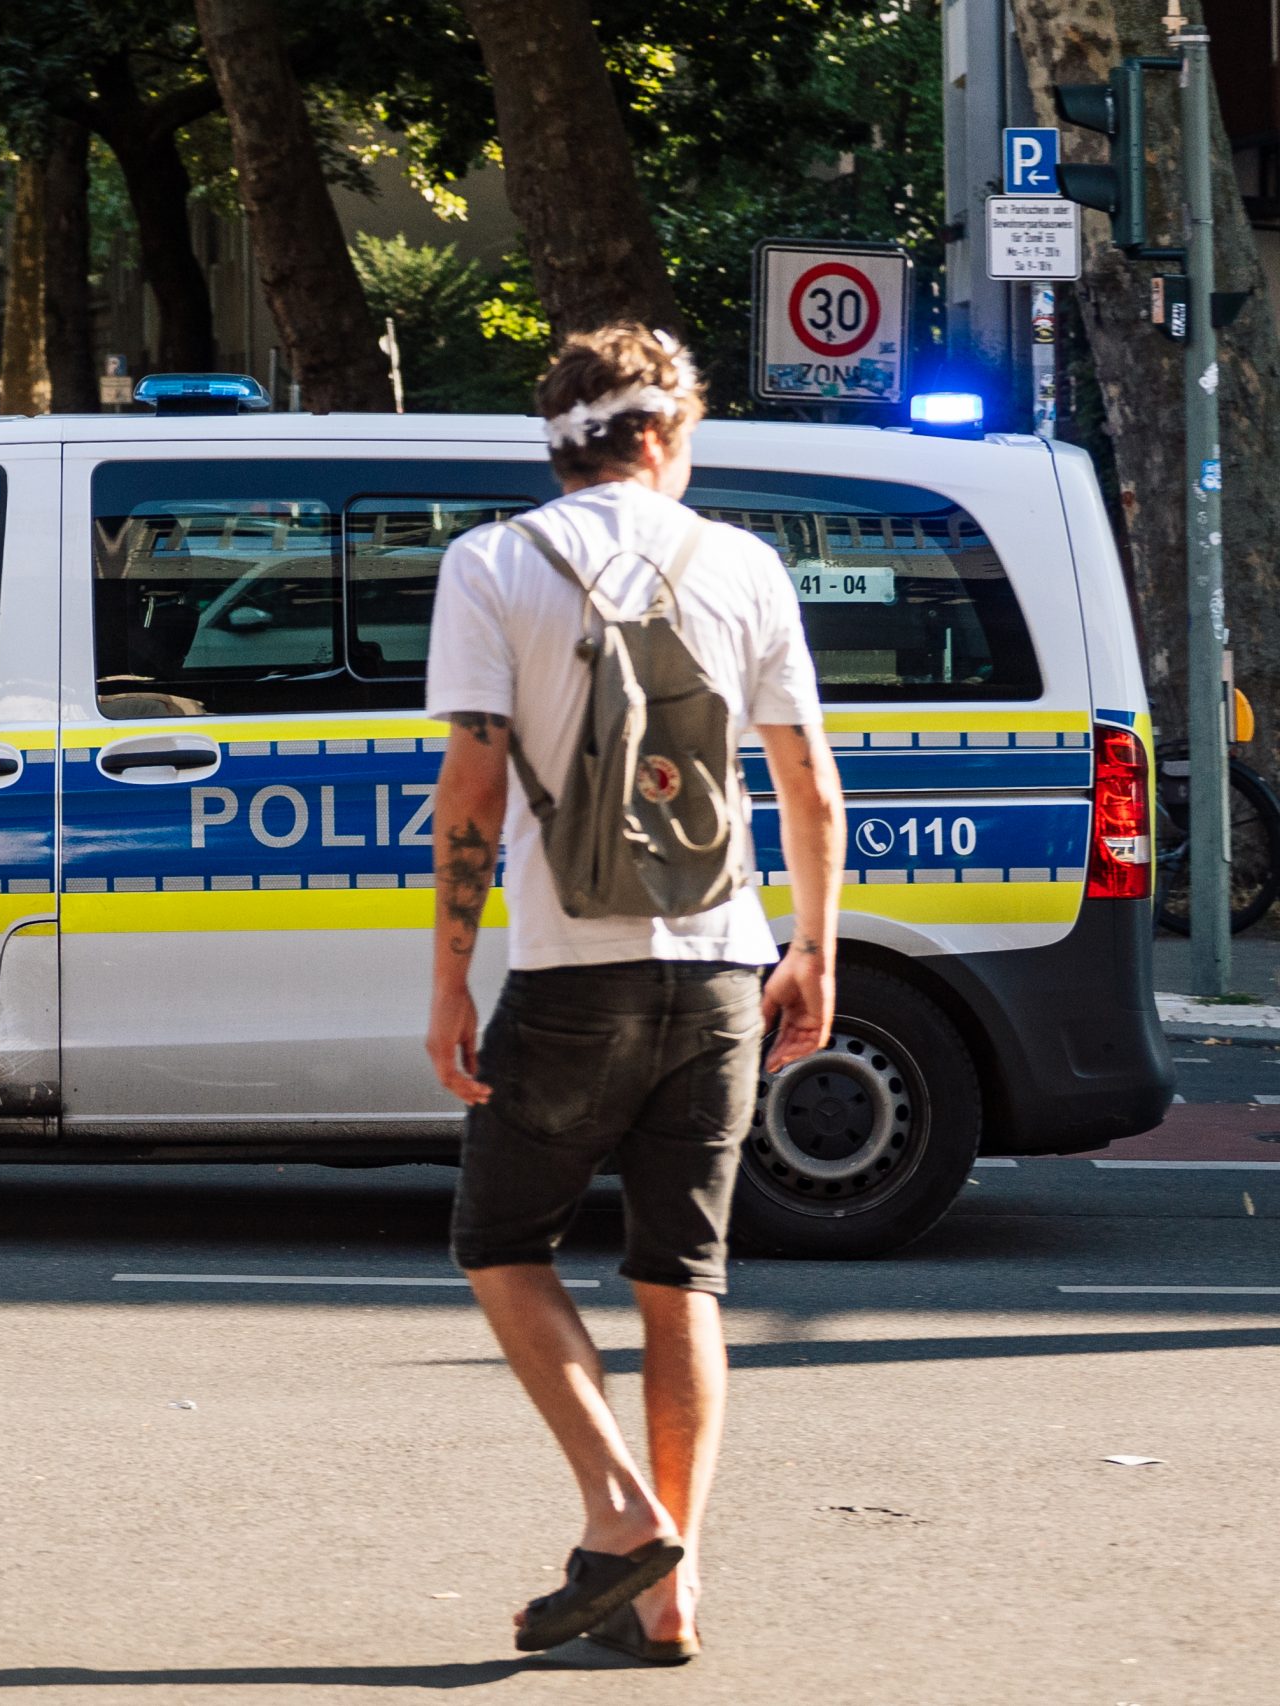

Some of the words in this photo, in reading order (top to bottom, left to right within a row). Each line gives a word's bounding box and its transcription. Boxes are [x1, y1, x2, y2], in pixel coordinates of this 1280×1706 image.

[1013, 137, 1043, 186] P
[808, 288, 862, 331] 30
[800, 575, 821, 594] 41
[843, 575, 866, 594] 04
[190, 784, 438, 848] POLIZ
[899, 817, 977, 856] 110
